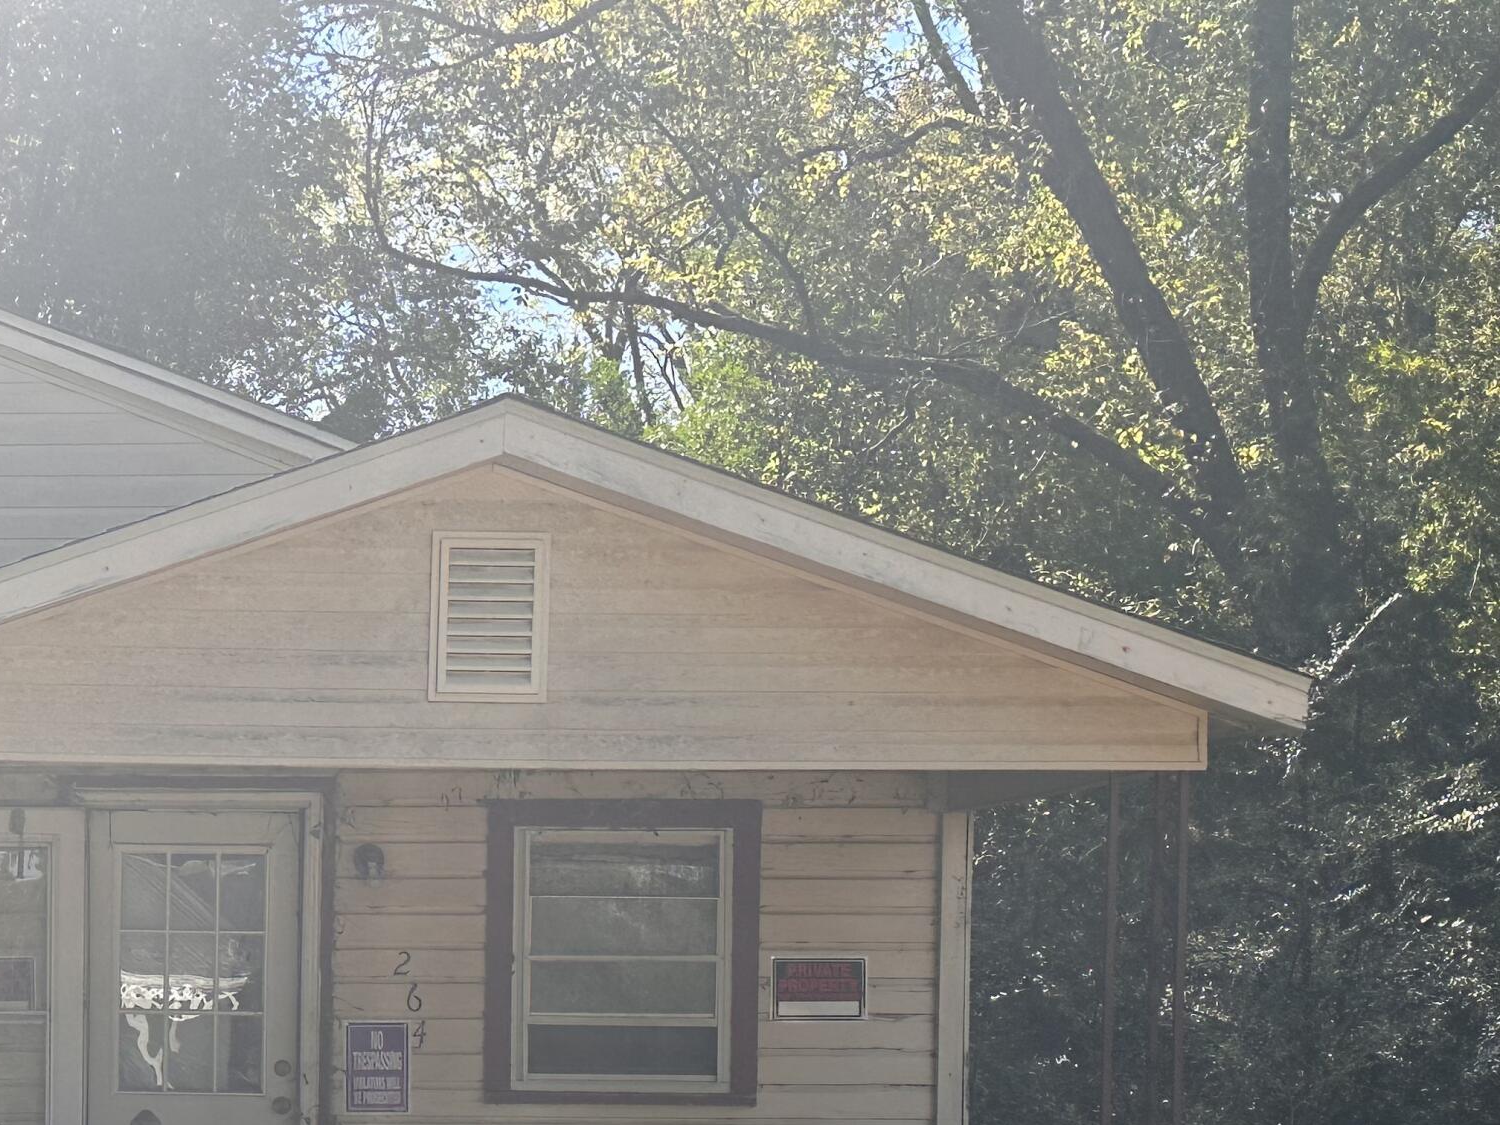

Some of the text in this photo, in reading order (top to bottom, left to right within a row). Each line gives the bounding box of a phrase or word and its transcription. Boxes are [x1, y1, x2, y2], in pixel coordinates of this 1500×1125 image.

[788, 963, 853, 977] PRIVATE
[778, 978, 858, 992] PROPERTY
[370, 1030, 384, 1050] NO
[352, 1051, 403, 1071] TRESPASSING
